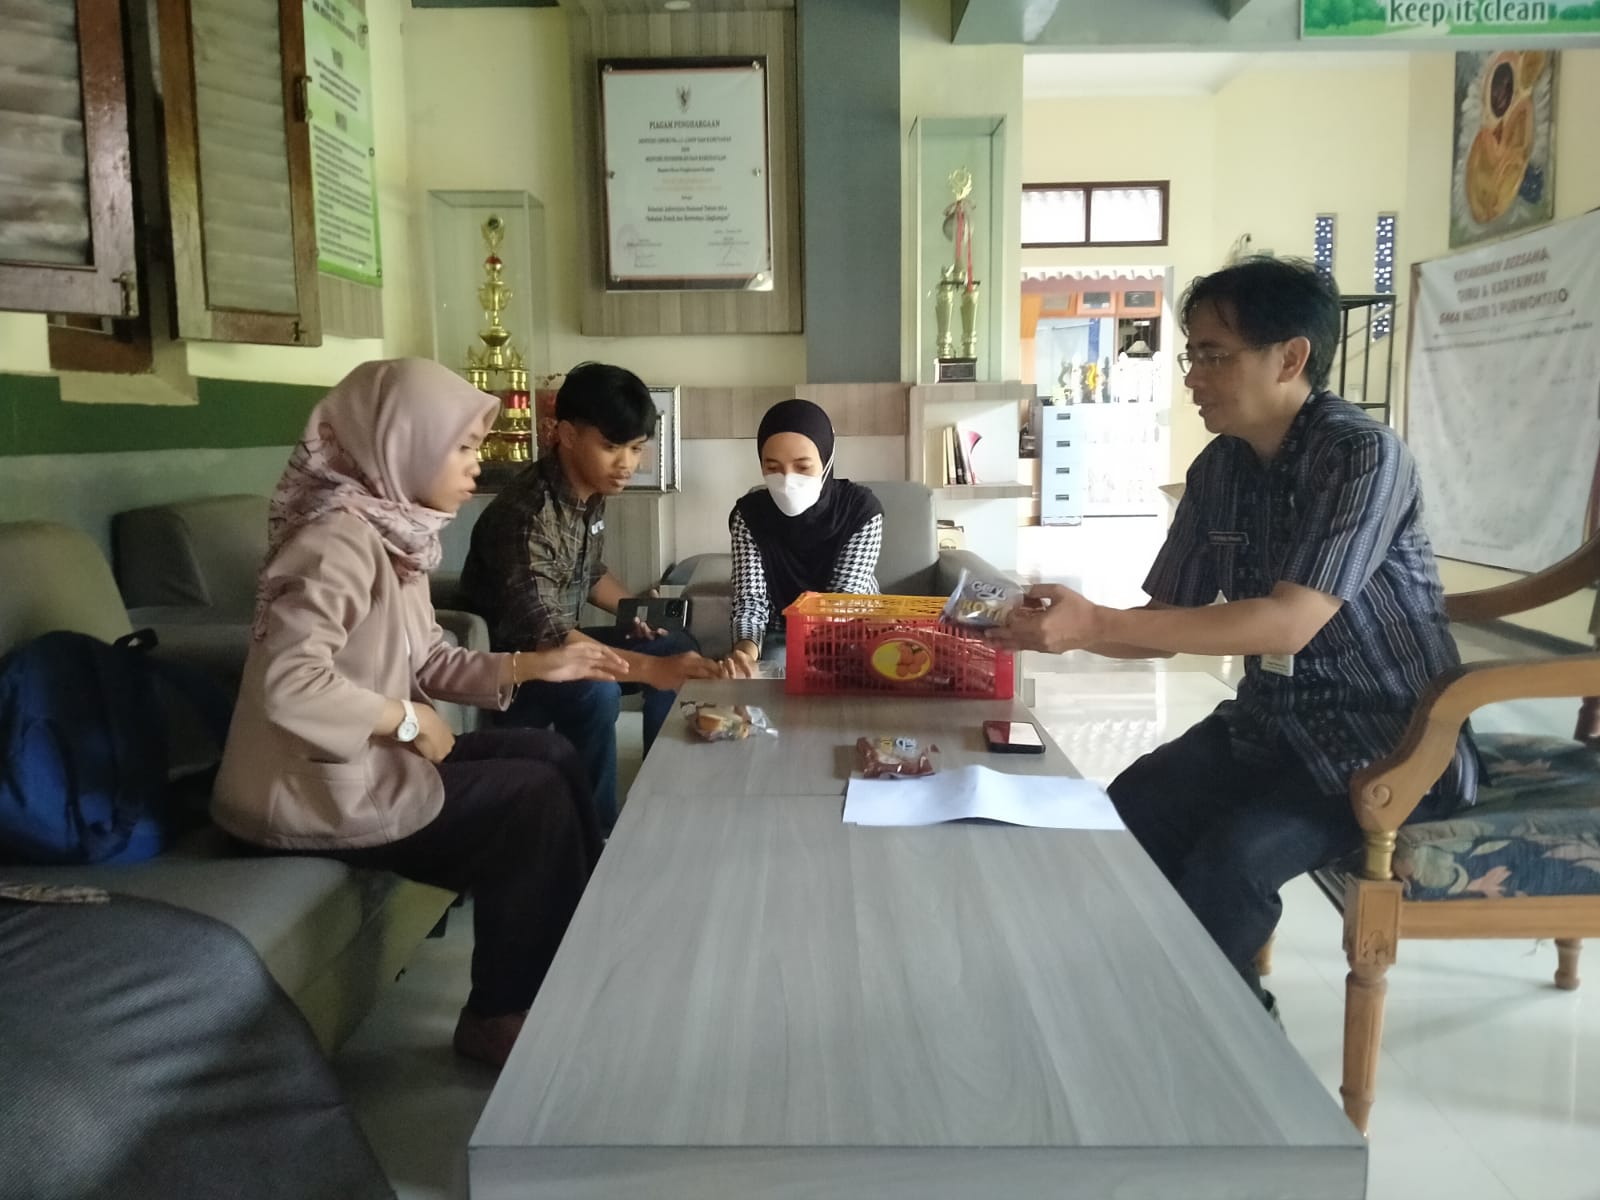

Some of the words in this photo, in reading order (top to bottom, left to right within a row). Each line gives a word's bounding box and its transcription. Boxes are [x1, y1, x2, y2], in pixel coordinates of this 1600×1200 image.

[1390, 0, 1445, 28] keep
[1456, 0, 1475, 22] it
[1484, 0, 1545, 22] clean
